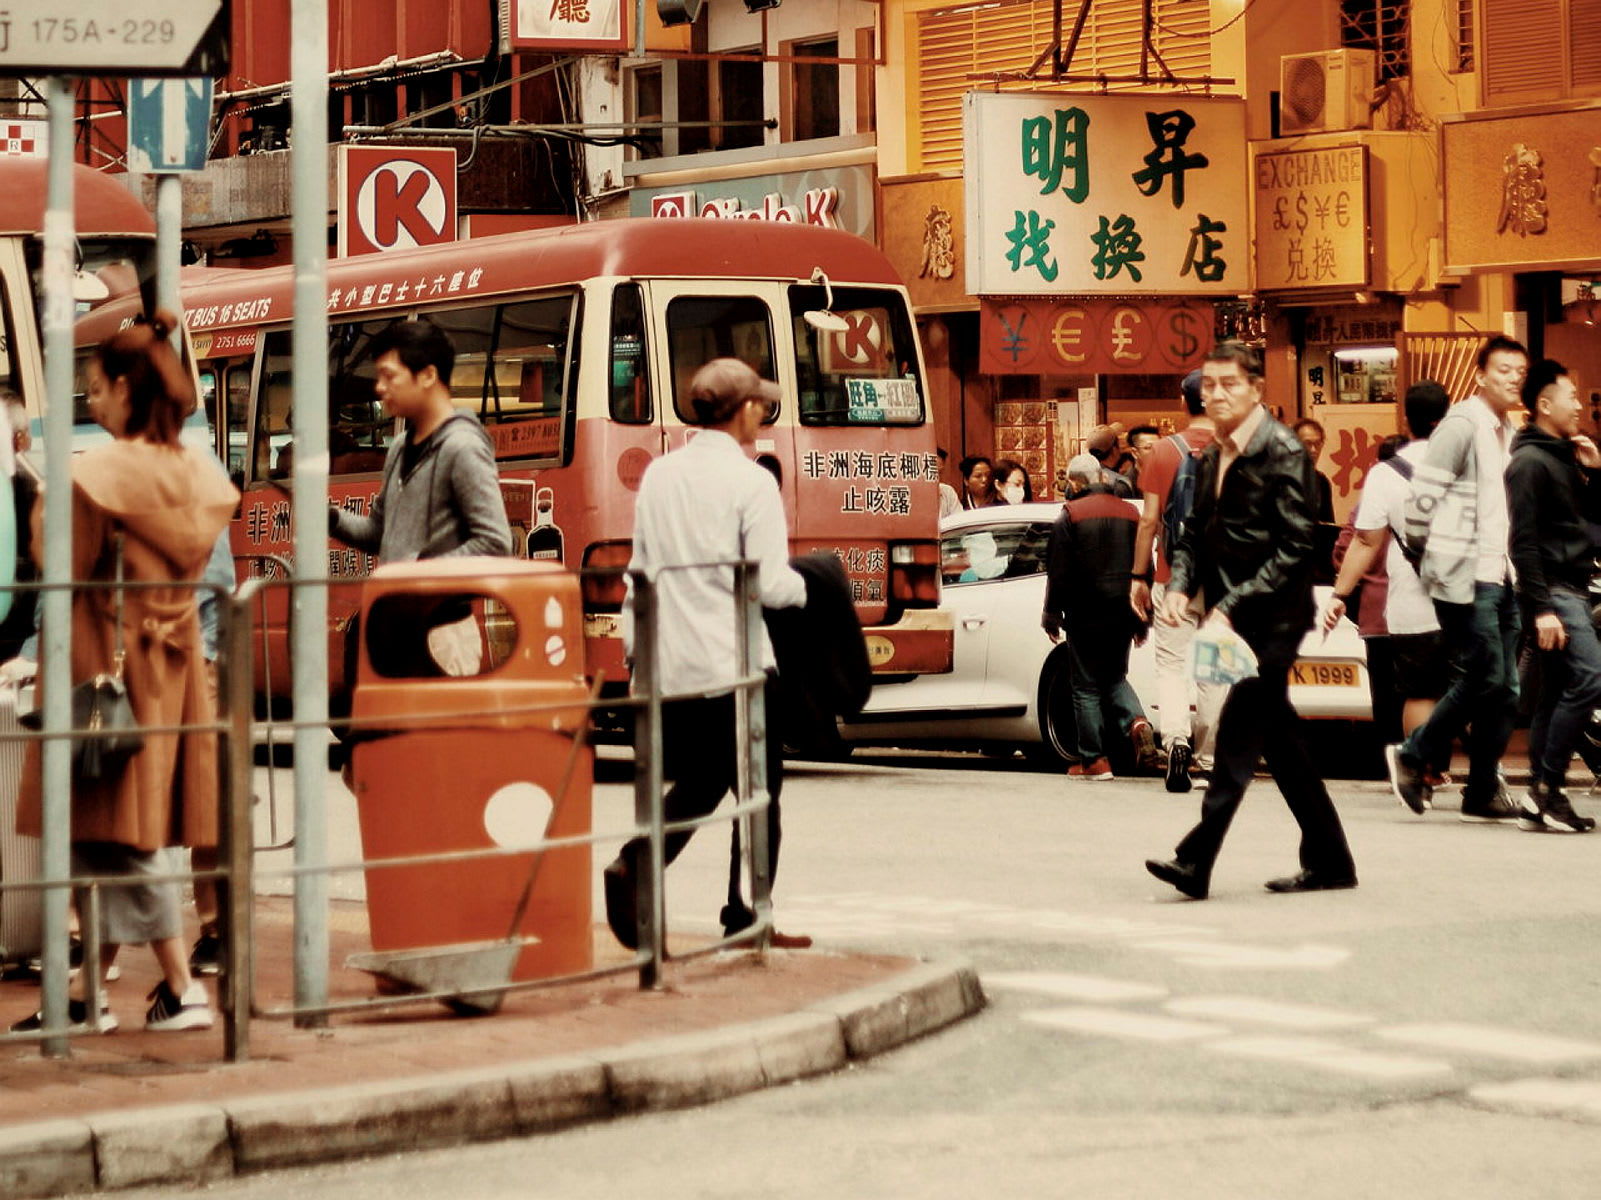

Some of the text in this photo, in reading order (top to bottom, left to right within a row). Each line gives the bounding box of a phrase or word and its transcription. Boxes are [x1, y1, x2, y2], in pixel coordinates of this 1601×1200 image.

[1021, 105, 1210, 209] 明昇
[1257, 150, 1361, 190] EXCHANGE
[375, 168, 442, 247] K
[1004, 210, 1228, 284] 找換店
[192, 304, 219, 327] BUS
[218, 304, 231, 324] 16
[232, 298, 272, 322] SEATS
[841, 485, 911, 516] 止咳露
[1311, 666, 1354, 685] 1999
